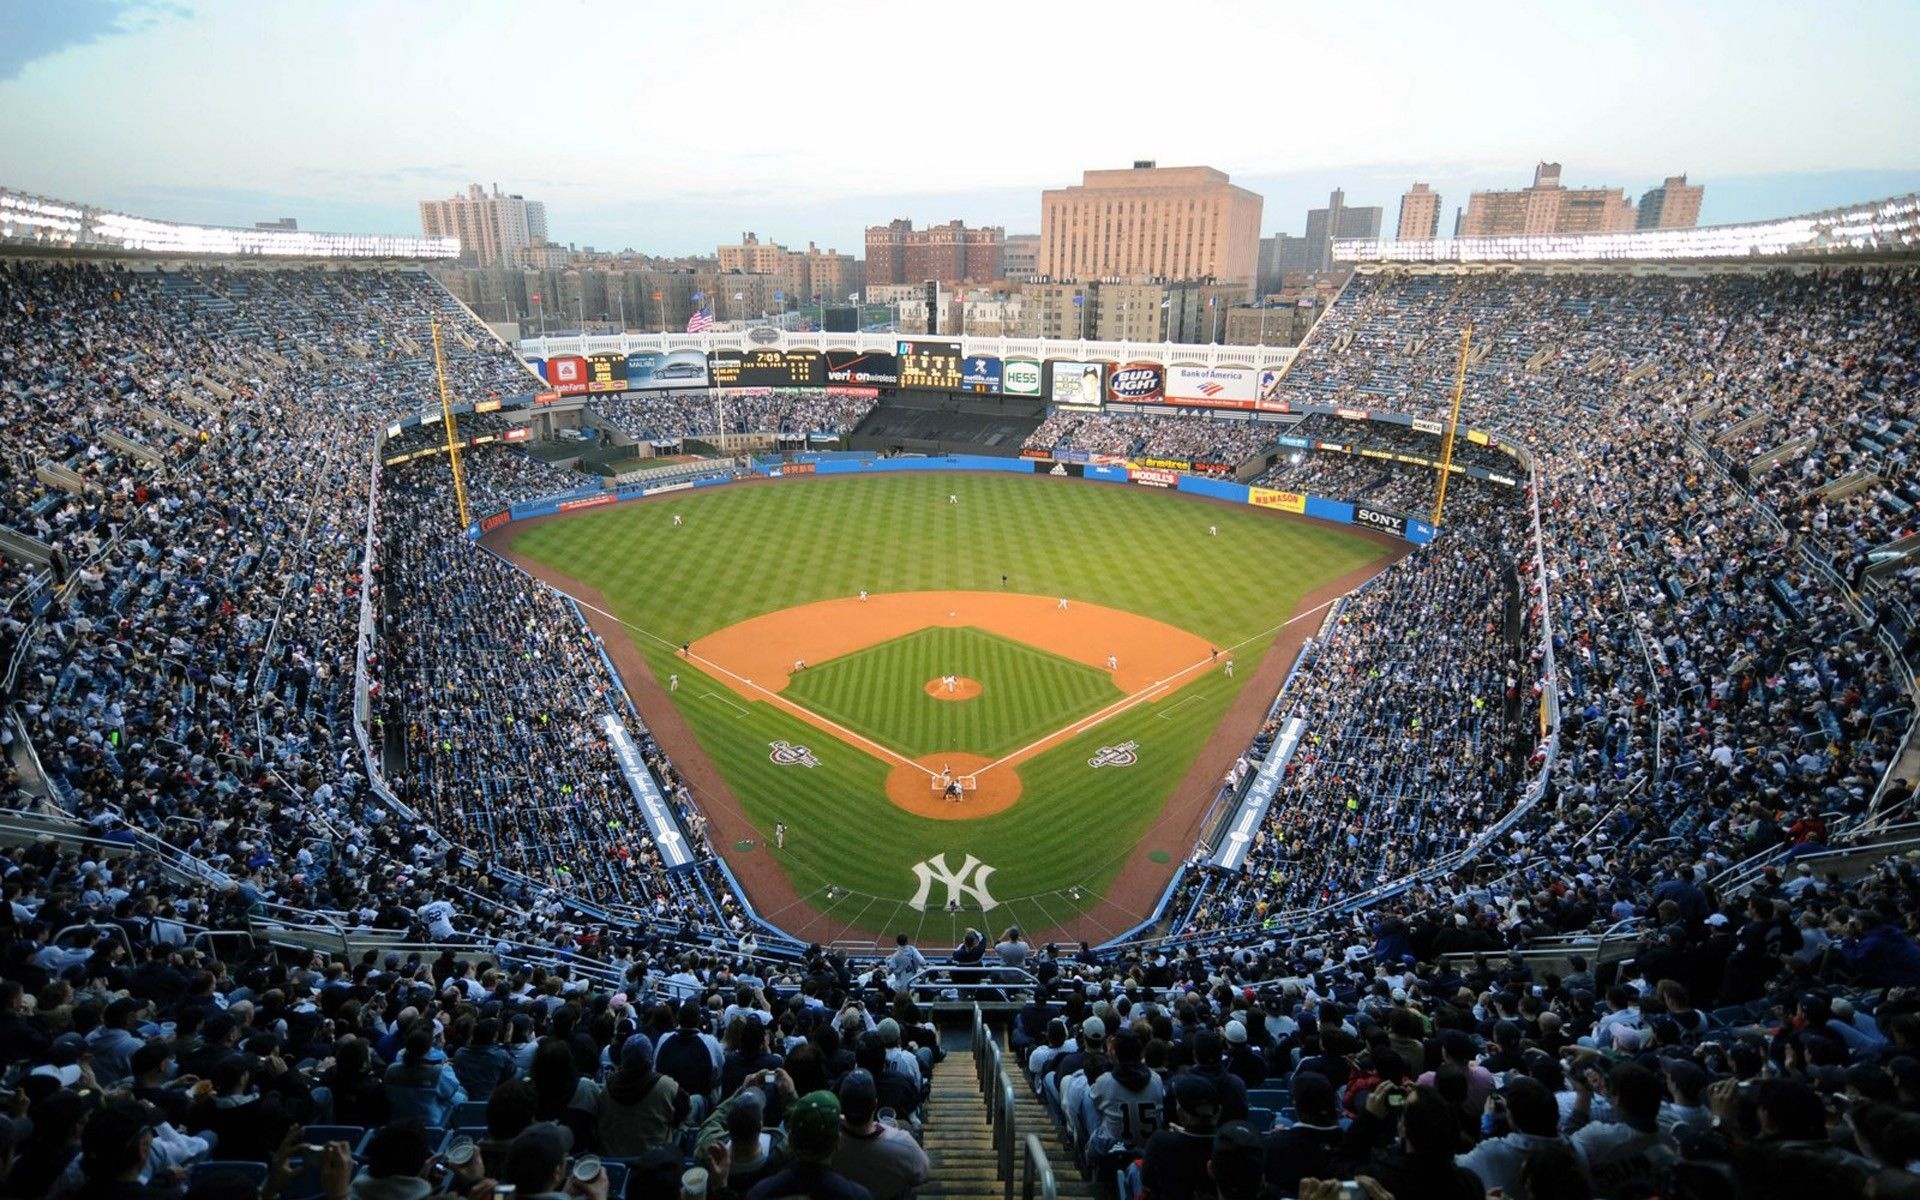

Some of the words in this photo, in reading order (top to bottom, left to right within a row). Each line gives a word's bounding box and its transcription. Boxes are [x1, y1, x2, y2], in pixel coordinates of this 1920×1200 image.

[757, 353, 781, 362] 7:09
[828, 369, 870, 384] verizon
[869, 373, 898, 384] wireless
[1007, 372, 1037, 384] HESS
[1118, 370, 1154, 381] BUD
[1181, 369, 1199, 377] Bank
[1201, 370, 1209, 378] of
[1210, 371, 1243, 380] America
[569, 383, 586, 391] Farm
[1113, 380, 1157, 391] LIGHT
[1131, 470, 1175, 483] MODELL'S
[1358, 509, 1401, 528] SONY
[428, 910, 442, 923] 62
[1120, 1102, 1158, 1139] 15
